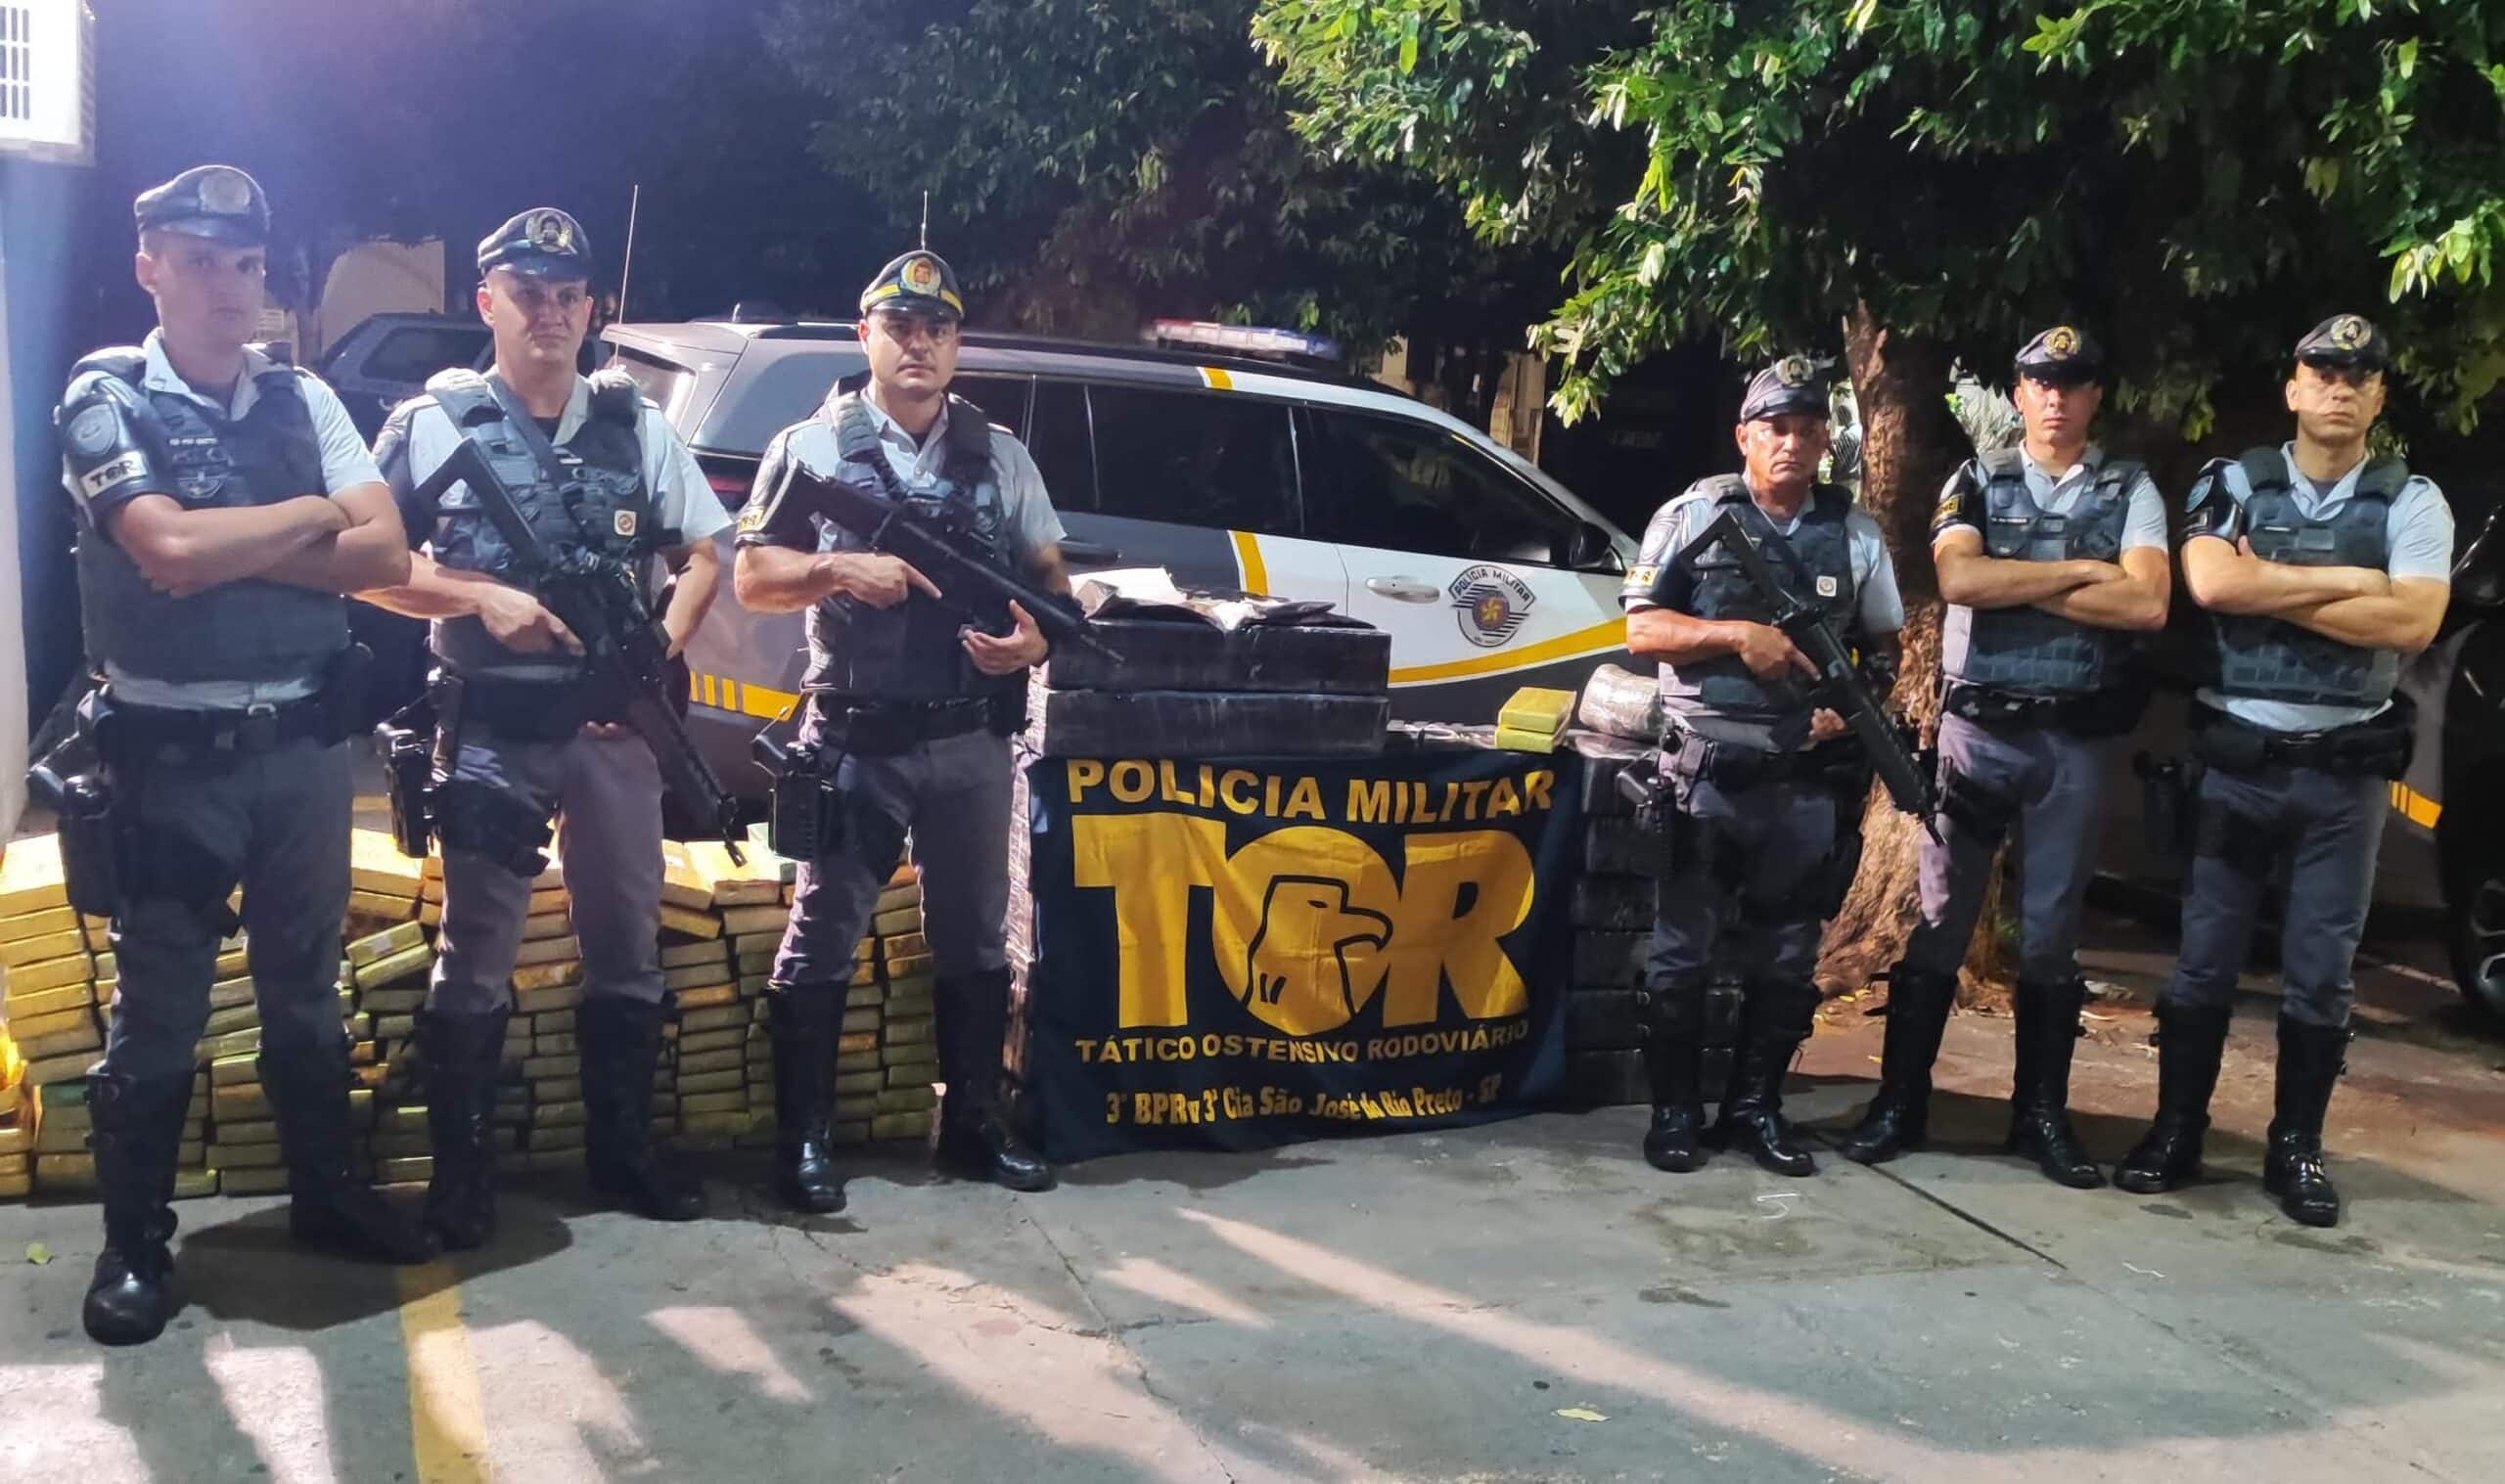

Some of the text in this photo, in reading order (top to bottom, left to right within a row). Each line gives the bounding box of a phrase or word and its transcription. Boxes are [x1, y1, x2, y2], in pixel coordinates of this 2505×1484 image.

[1492, 570, 1530, 602] MILITAR
[1346, 770, 1554, 824] MILITAR
[1071, 812, 1534, 1036] TOR
[1074, 1019, 1529, 1064] TÁTICO OSTENSIVO RODOVIÁRIO
[1134, 1092, 1200, 1124] BPRv
[1223, 1086, 1254, 1120] Cia
[1259, 1085, 1302, 1116] São
[1307, 1092, 1361, 1119] José
[1379, 1090, 1413, 1117] Rio
[1411, 1087, 1463, 1116] Preto
[1479, 1072, 1502, 1103] SP
